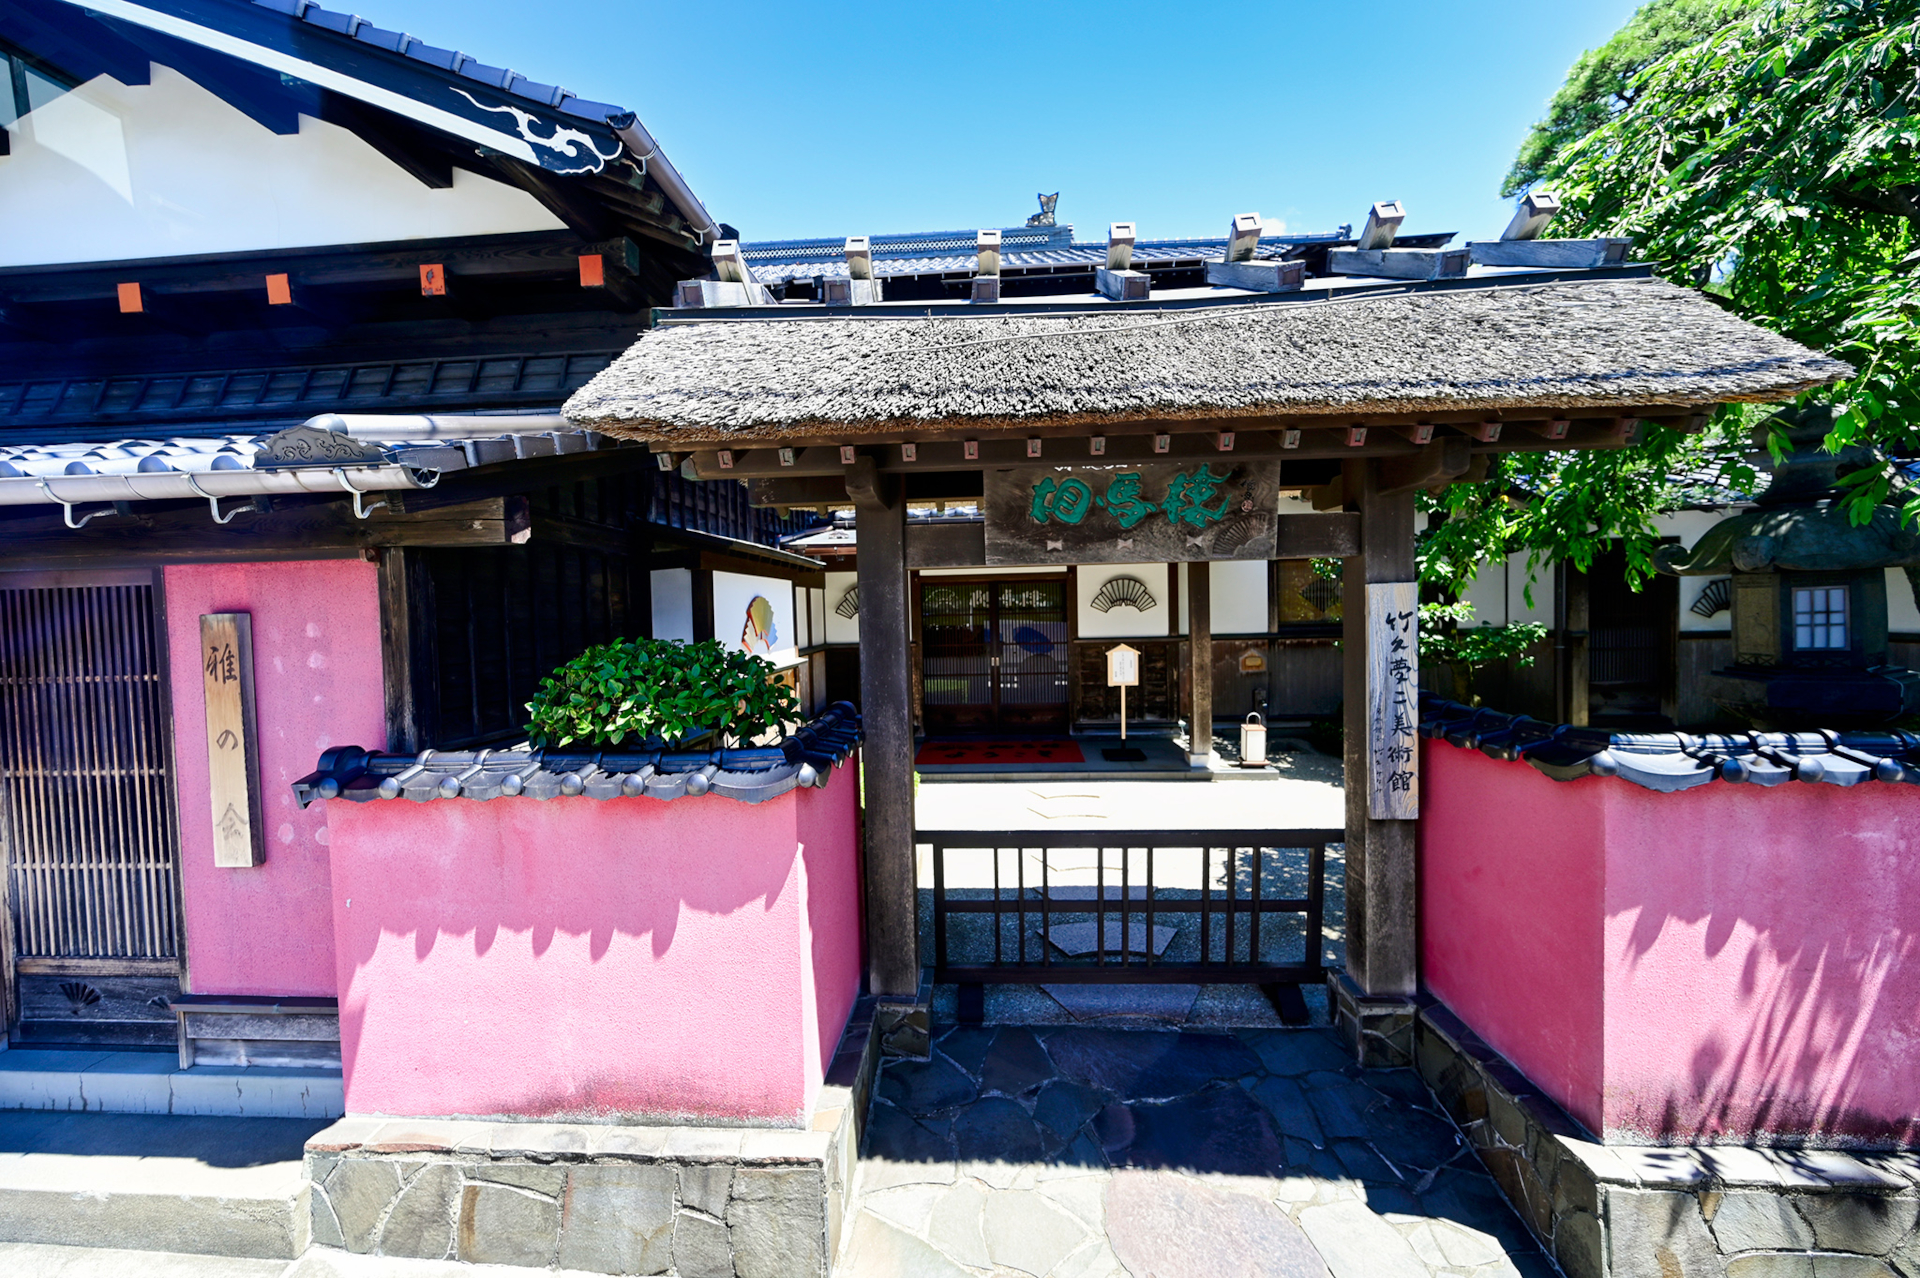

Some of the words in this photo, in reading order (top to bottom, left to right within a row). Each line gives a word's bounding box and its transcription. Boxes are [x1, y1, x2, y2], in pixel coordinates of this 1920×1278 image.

[205, 643, 249, 842] 雅の会
[1385, 610, 1414, 792] 竹久夢二美術館
